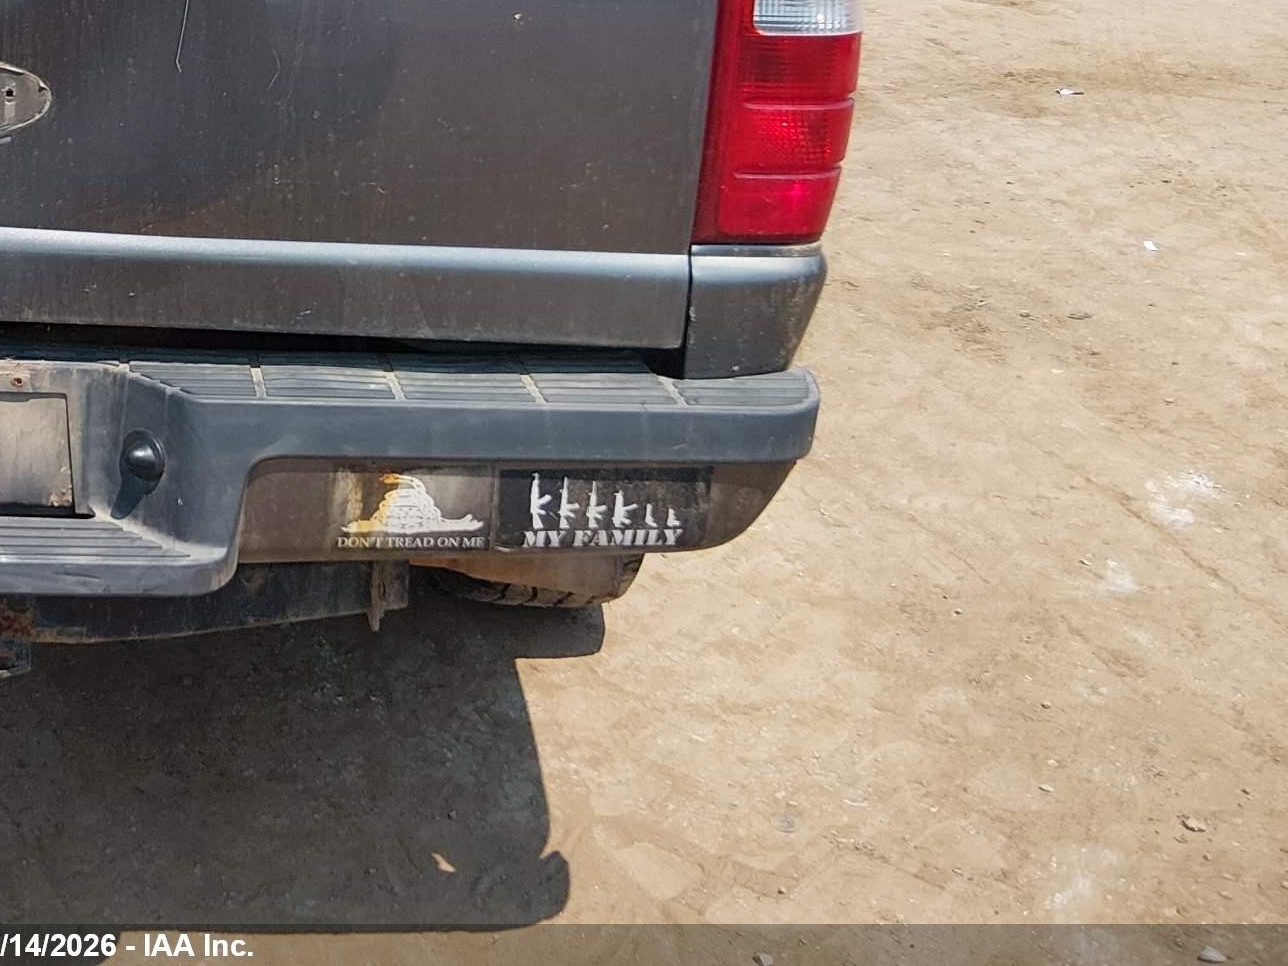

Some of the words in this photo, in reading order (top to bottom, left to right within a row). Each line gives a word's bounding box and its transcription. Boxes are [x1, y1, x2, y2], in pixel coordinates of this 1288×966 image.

[336, 536, 384, 548] DON'T
[386, 536, 434, 548] TREAD
[437, 536, 460, 548] ON
[462, 536, 484, 548] ME
[521, 530, 567, 547] MY
[572, 529, 684, 546] FAMILY
